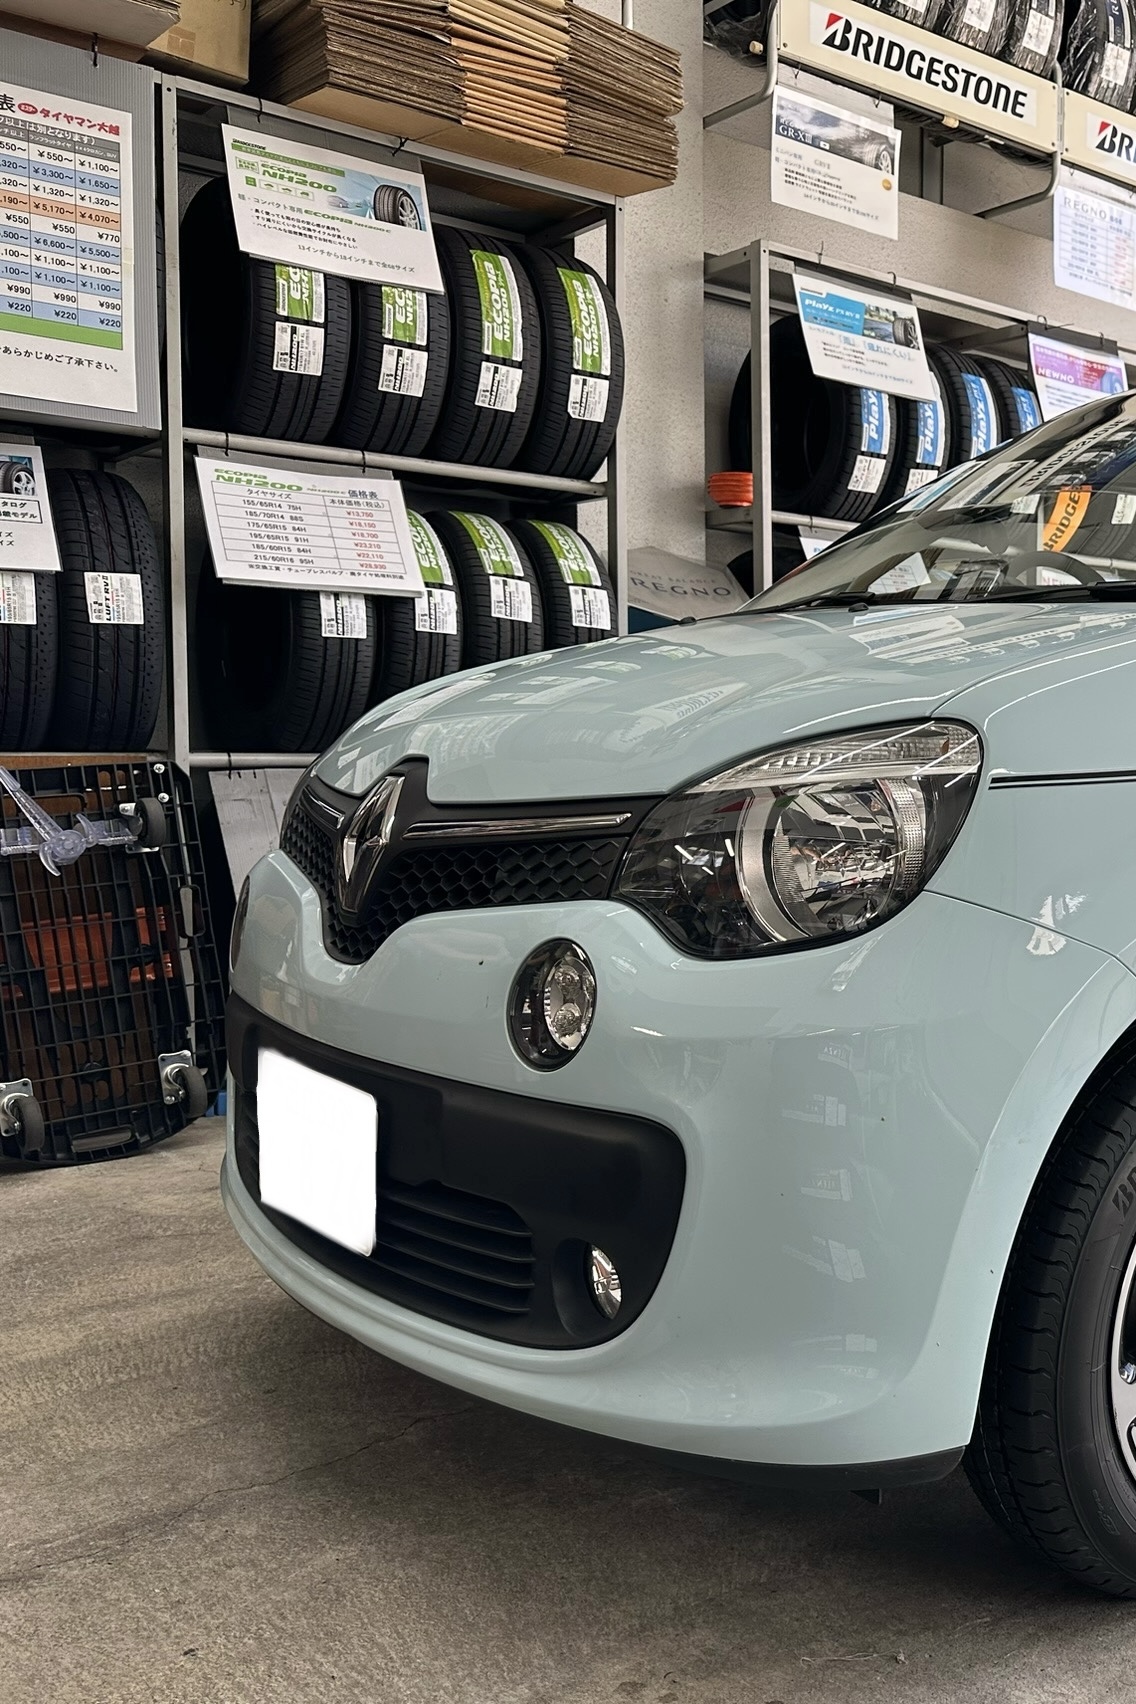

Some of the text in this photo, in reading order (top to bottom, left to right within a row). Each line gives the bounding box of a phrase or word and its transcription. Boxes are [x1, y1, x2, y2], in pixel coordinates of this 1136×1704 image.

[822, 12, 1029, 118] BRIDGESTONE
[260, 163, 306, 178] ECOPIA
[262, 169, 337, 193] NH200
[1064, 196, 1107, 220] REGNO
[5, 213, 120, 243] ¥550 ¥550 ¥770
[6, 284, 121, 311] ¥990 ¥990 ¥990
[7, 301, 121, 328] ¥220 ¥220 ¥220
[1038, 367, 1075, 384] NEWNO
[214, 468, 268, 481] ECOPIA
[216, 474, 303, 492] NH200
[348, 489, 379, 501] 価格表
[247, 488, 292, 501] タイヤサイズ
[630, 577, 731, 598] REGNO
